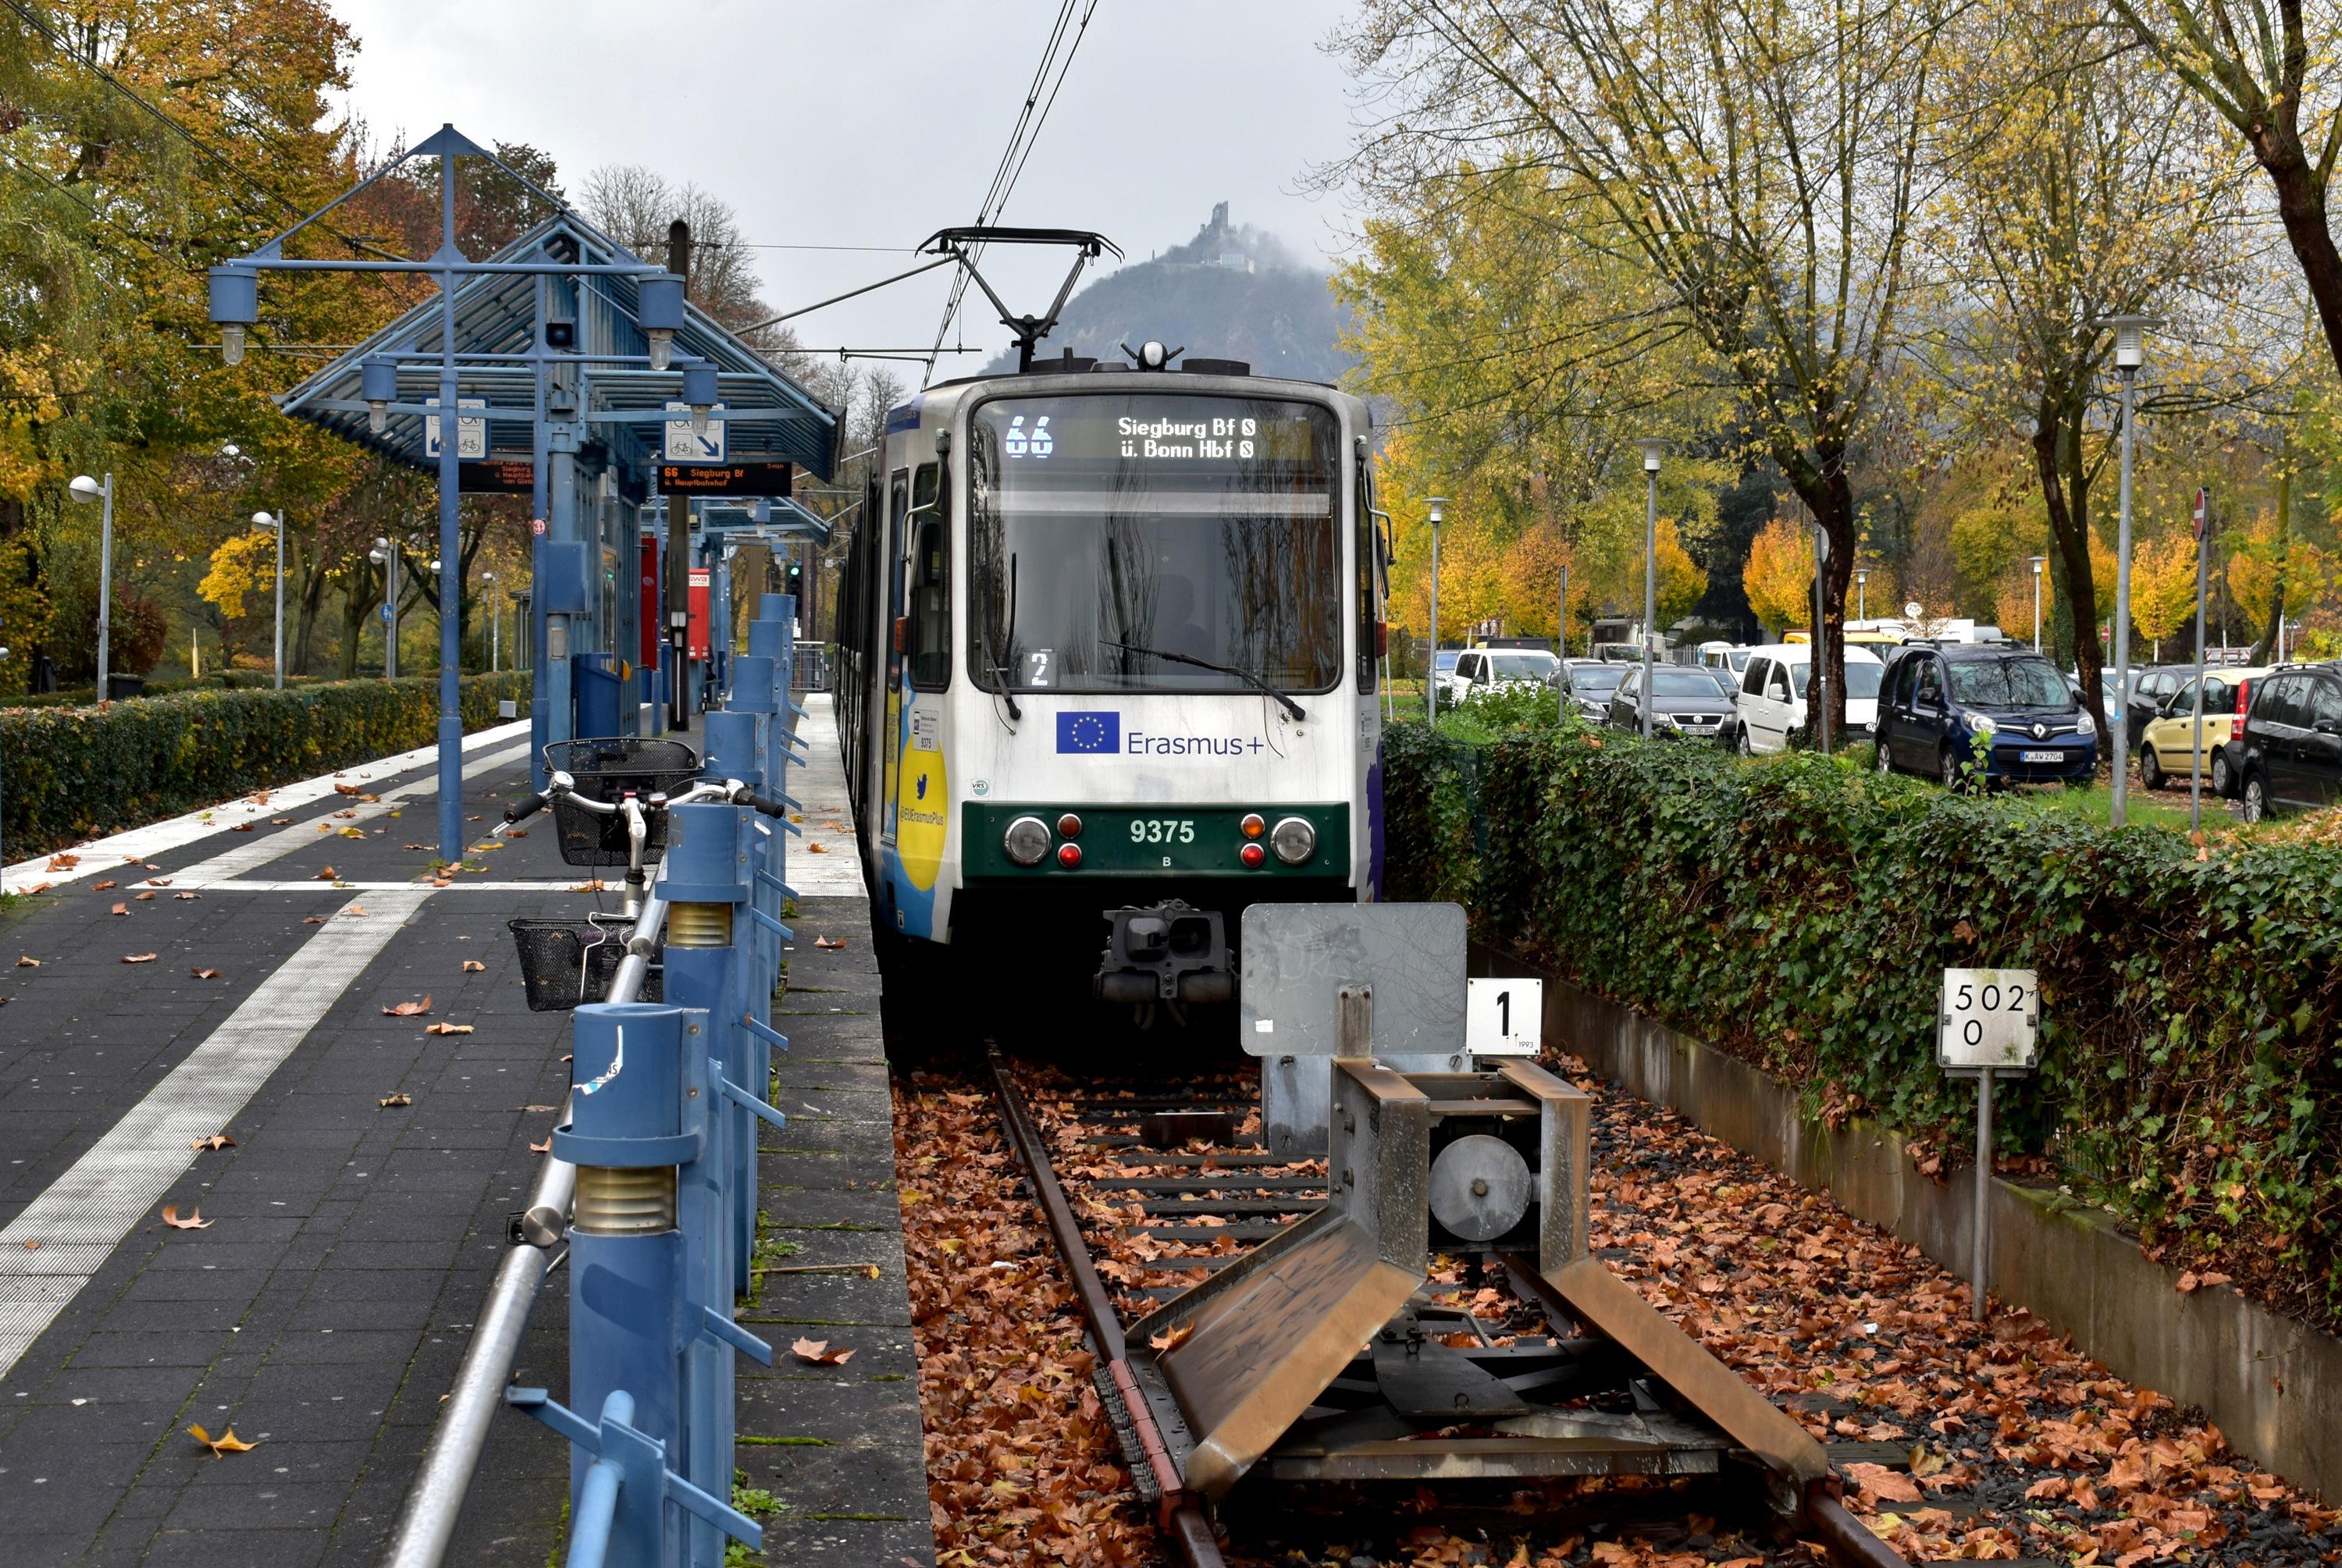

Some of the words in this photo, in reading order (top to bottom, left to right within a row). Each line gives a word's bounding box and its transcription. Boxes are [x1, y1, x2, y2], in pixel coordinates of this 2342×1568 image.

[1005, 416, 1052, 457] 66
[1119, 417, 1206, 439] Siegburg
[1212, 418, 1235, 436] Bf
[1121, 440, 1137, 457] ü.
[1144, 439, 1192, 457] Bonn
[1200, 440, 1233, 457] Hbf
[664, 468, 678, 477] 66
[690, 468, 731, 478] Siegburg
[735, 469, 744, 478] Bf
[1031, 653, 1048, 686] 2
[920, 737, 932, 749] 9375
[1128, 732, 1264, 755] Erasmus+
[899, 806, 944, 827] @EUErasmusPlus
[1130, 820, 1194, 844] 9375
[1162, 857, 1171, 866] B
[1955, 984, 2024, 1012] 502
[1497, 991, 1510, 1036] 1
[1963, 1019, 1983, 1046] 0
